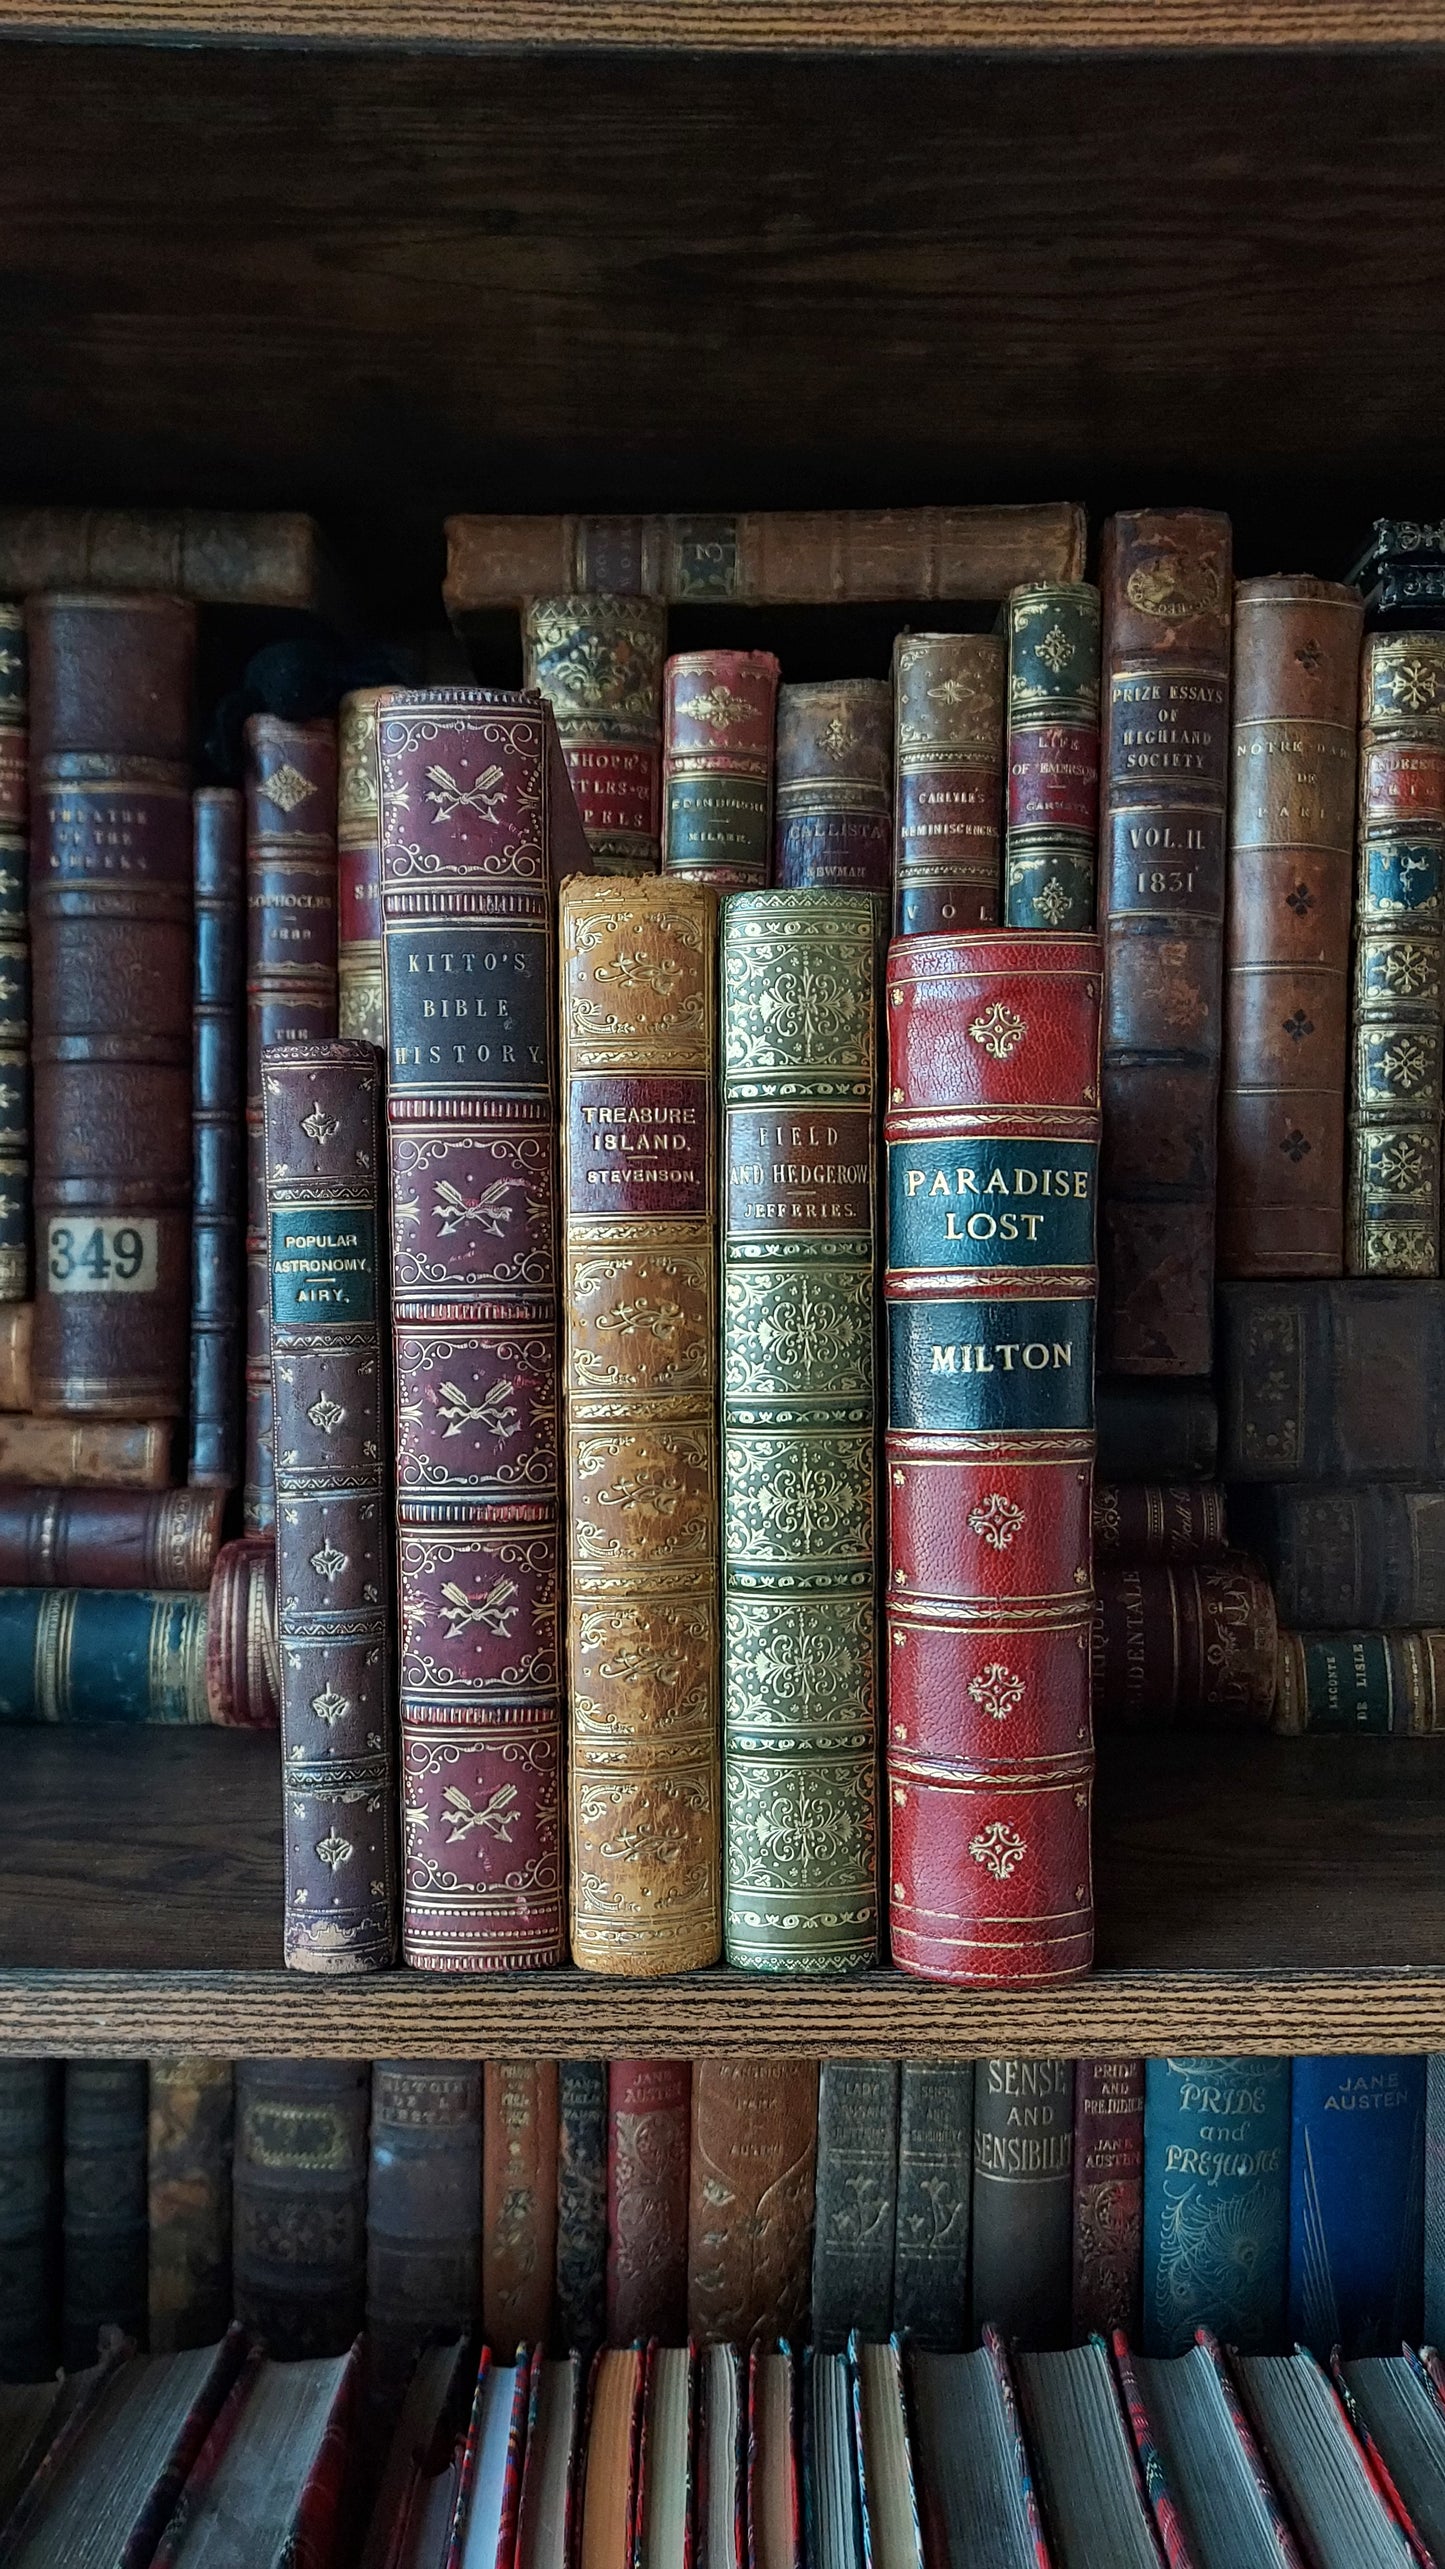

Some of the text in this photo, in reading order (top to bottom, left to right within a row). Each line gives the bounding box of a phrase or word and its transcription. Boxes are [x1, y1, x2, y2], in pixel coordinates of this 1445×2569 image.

[1112, 685, 1223, 704] PRIZE ESSAYS
[1158, 708, 1179, 723] OF
[1123, 730, 1212, 746] HIGHLAND
[1012, 763, 1030, 776] OF
[1127, 753, 1204, 769] SOCIETY
[918, 789, 985, 804] CARLYLE'S
[790, 823, 882, 839] CALLISTA
[1137, 872, 1192, 894] 1831
[248, 894, 332, 908] SOPHOCLES
[408, 953, 526, 973] KITTO'S
[423, 999, 509, 1018] BIBLE
[395, 1044, 545, 1065] HISTORY.
[581, 1106, 695, 1125] TREASURE
[592, 1133, 691, 1152] ISLAND.
[759, 1126, 839, 1147] FIELD
[587, 1169, 700, 1186] STEVENSON.
[729, 1164, 763, 1186] AND
[907, 1167, 1089, 1198] PARADISE
[744, 1203, 857, 1220] JEFFERIES.
[944, 1213, 1045, 1242] LOST
[285, 1235, 357, 1248] POPULAR
[50, 1228, 144, 1281] 349
[930, 1342, 1073, 1373] MILTON
[1353, 1643, 1367, 1688] LISLE
[1326, 1656, 1338, 1709] LECONTE
[633, 2071, 672, 2087] JANE
[988, 2059, 1066, 2098] SENSE
[1094, 2063, 1137, 2079] PRIDE
[1102, 2082, 1129, 2095] AND
[1339, 2073, 1400, 2093] JANE
[624, 2082, 683, 2104] AUSTEN
[1179, 2083, 1266, 2115] PRIDE
[1324, 2090, 1408, 2110] AUSTEN
[1084, 2096, 1143, 2114] PREJUDICE
[1007, 2106, 1054, 2127] AND
[1199, 2122, 1251, 2142] and
[1094, 2139, 1133, 2151] JANE
[1085, 2152, 1141, 2168] AUSTEN
[1165, 2144, 1281, 2187] PREJUDICE
